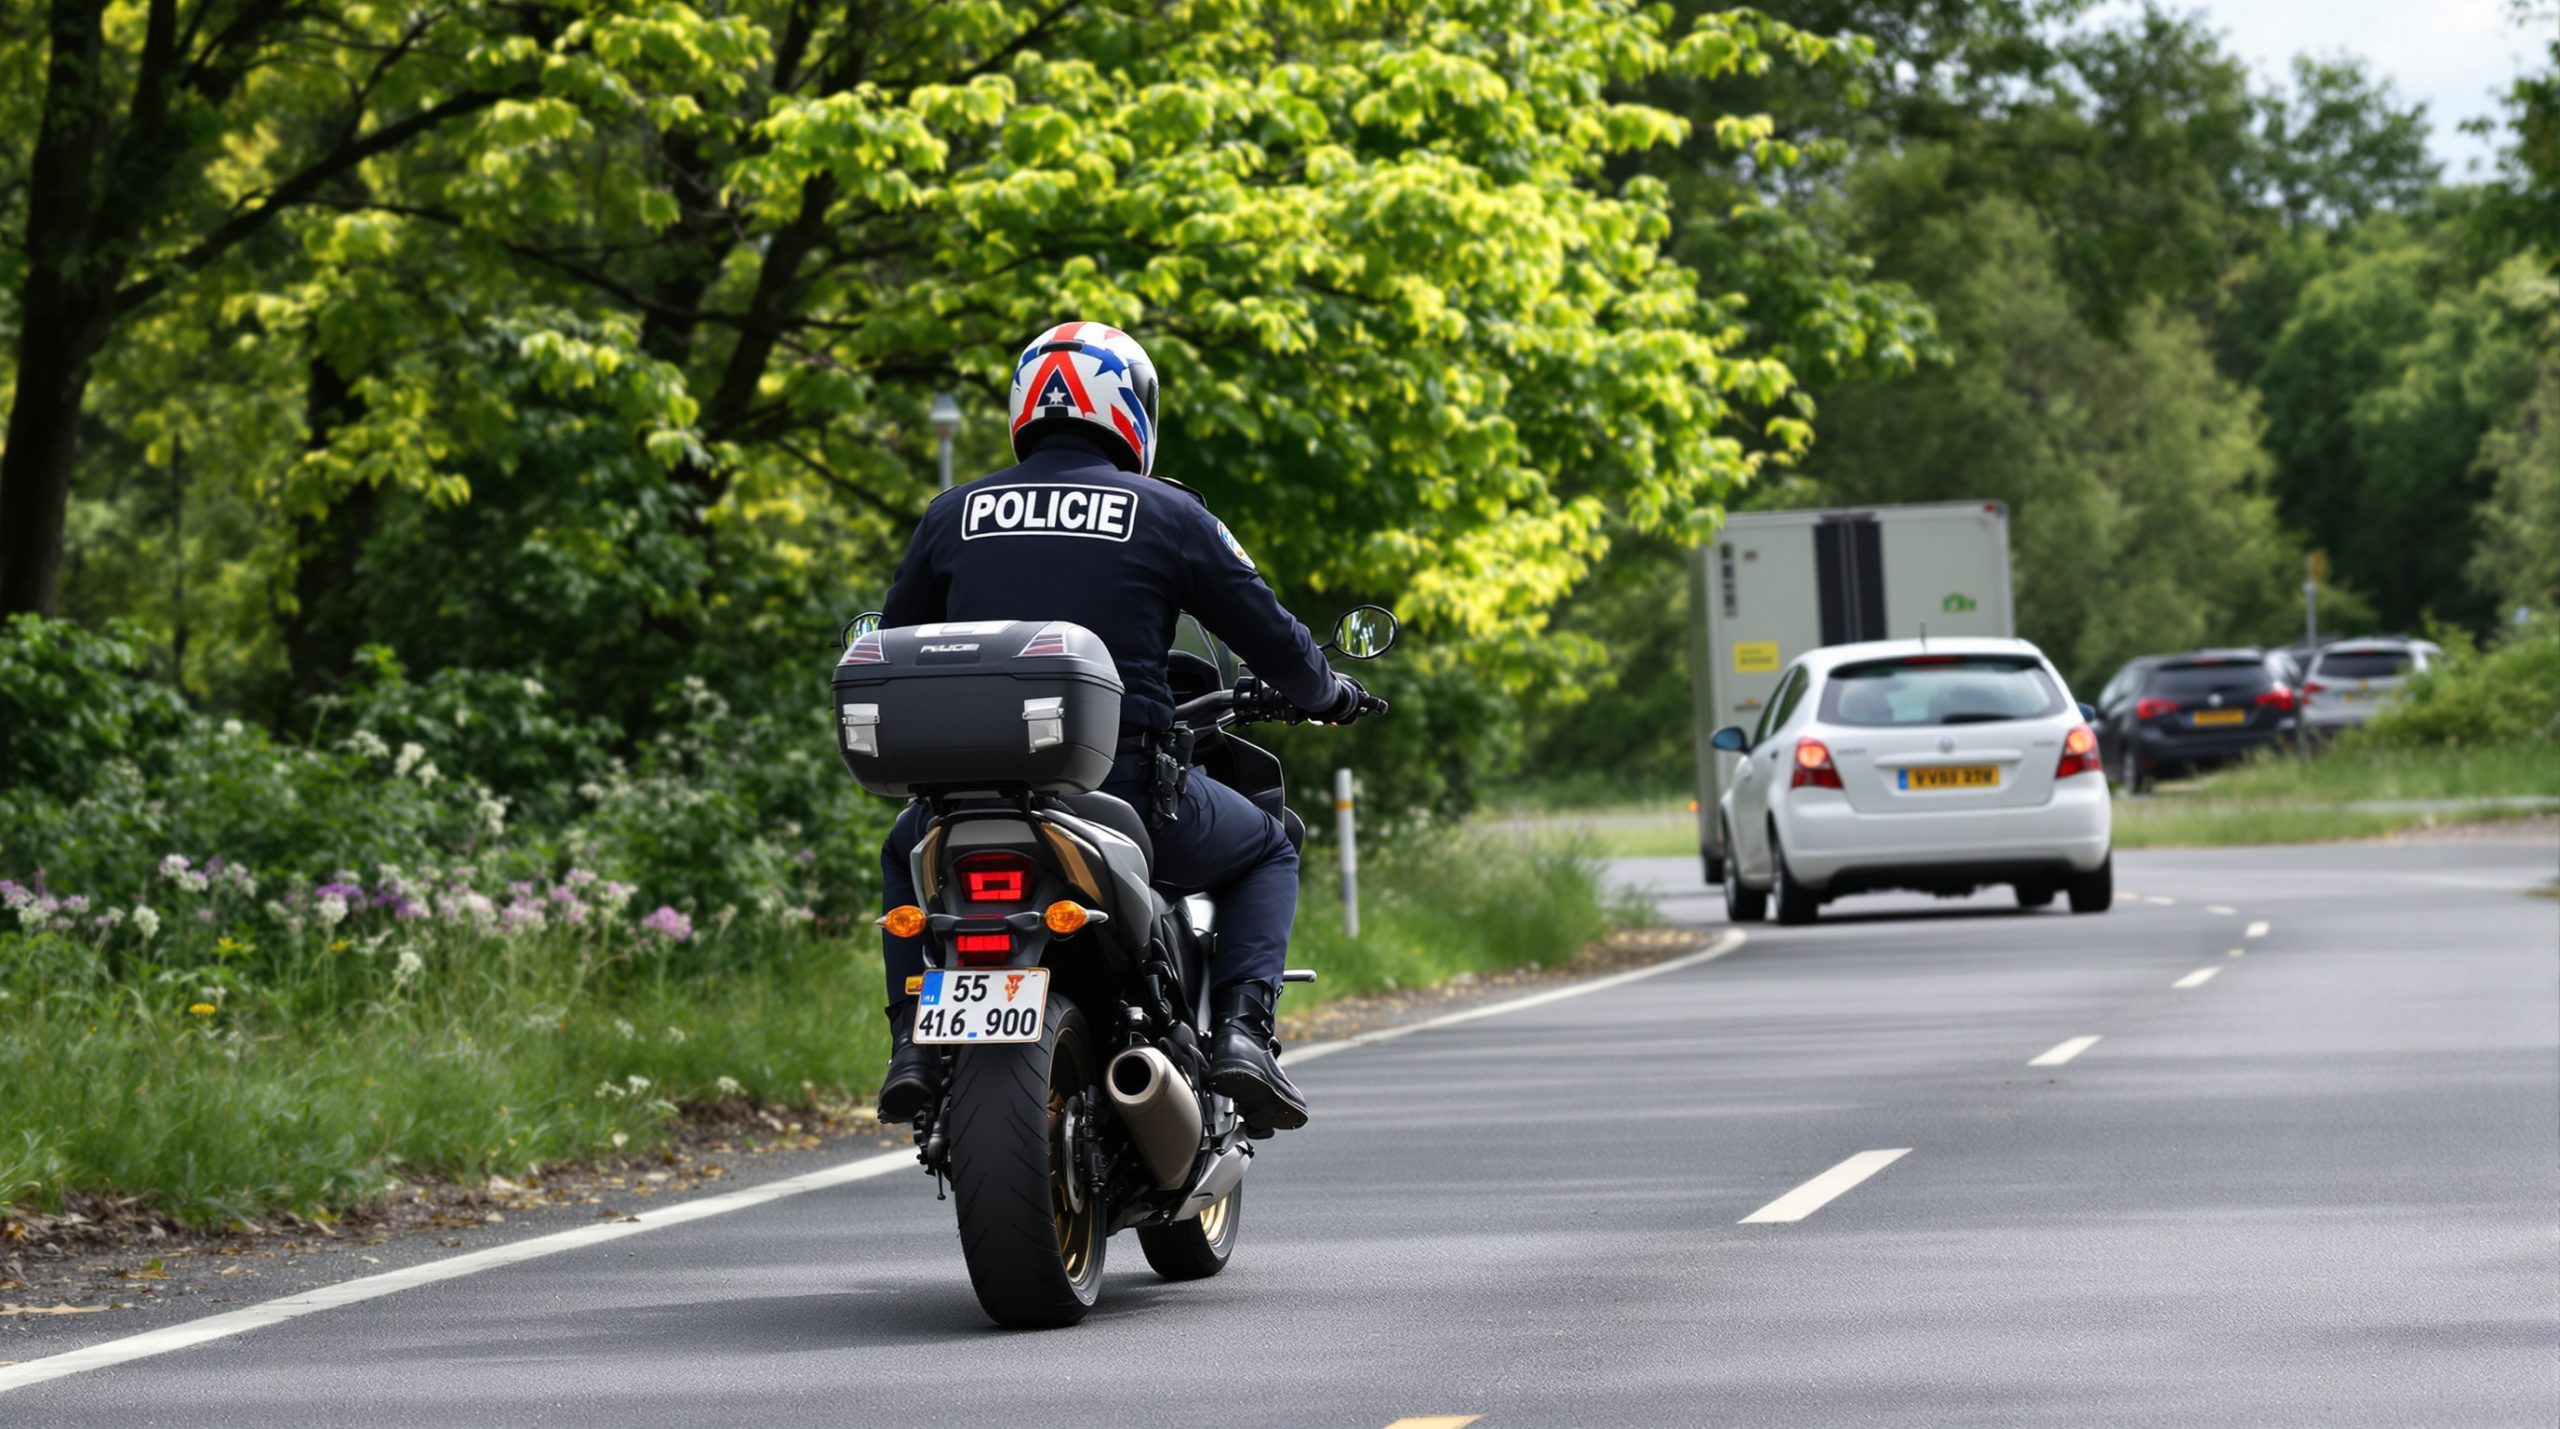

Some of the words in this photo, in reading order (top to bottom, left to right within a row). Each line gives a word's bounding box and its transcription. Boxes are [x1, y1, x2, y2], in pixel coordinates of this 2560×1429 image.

[969, 490, 1128, 534] POLICIE
[952, 974, 990, 1003] 55
[985, 1007, 1037, 1037] 900
